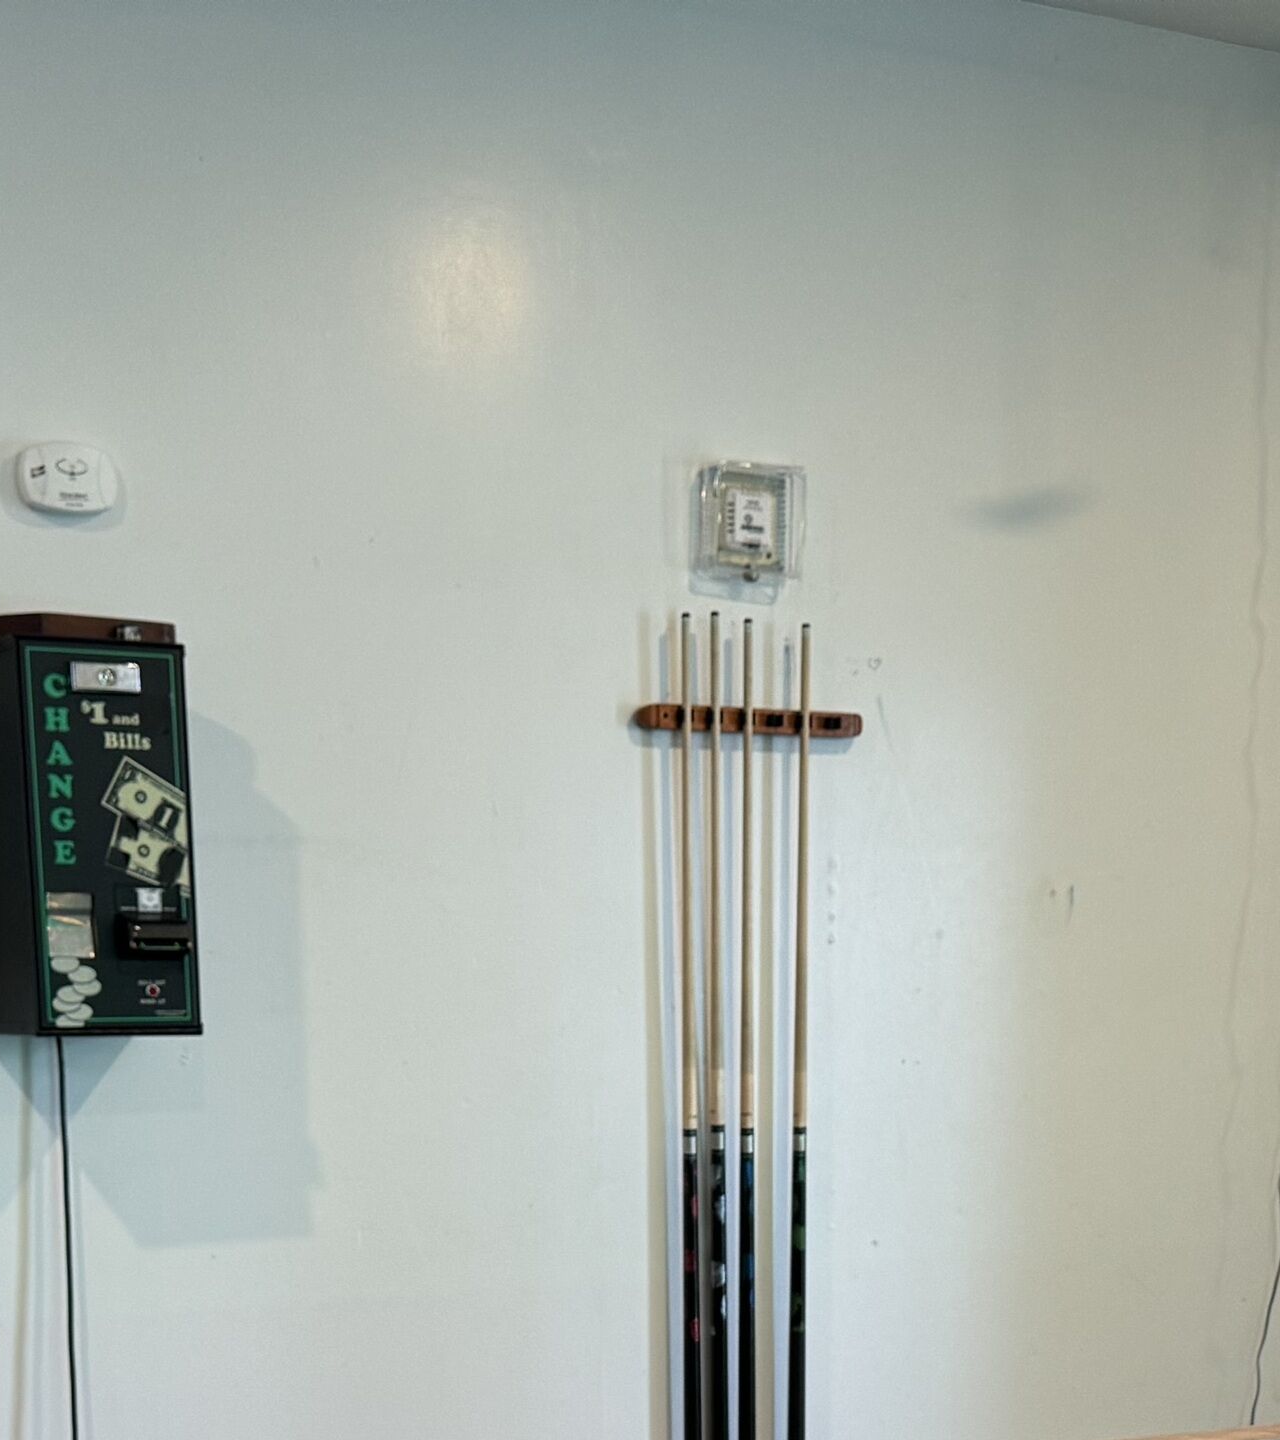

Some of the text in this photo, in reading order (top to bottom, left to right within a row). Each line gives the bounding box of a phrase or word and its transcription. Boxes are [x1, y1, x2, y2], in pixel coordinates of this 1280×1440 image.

[80, 700, 140, 726] $1 and
[103, 731, 152, 750] Bills
[42, 673, 76, 865] CHANGE
